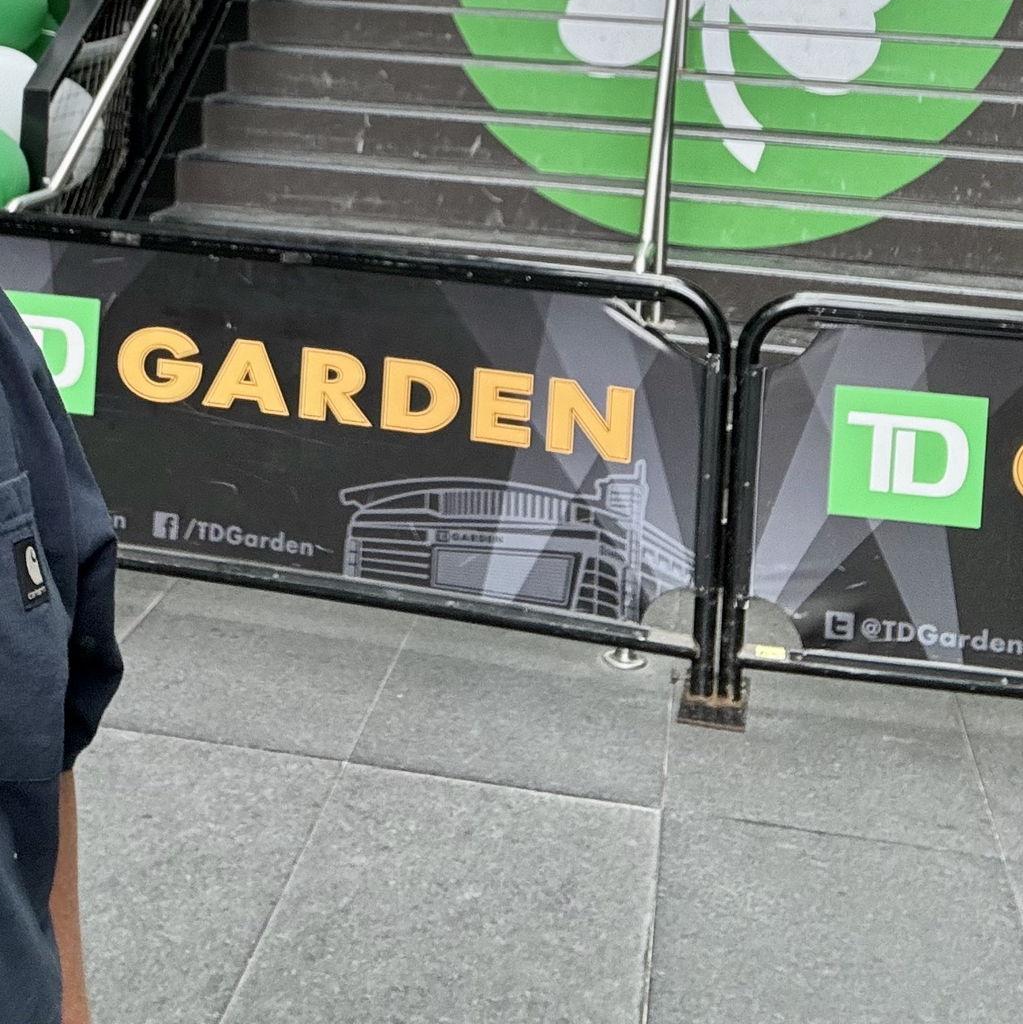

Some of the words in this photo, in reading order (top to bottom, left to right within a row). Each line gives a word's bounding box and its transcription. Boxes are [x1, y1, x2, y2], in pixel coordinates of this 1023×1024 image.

[20, 313, 85, 390] D
[117, 325, 636, 463] GARDEN
[847, 410, 970, 498] TD
[183, 517, 315, 557] /TDGarden
